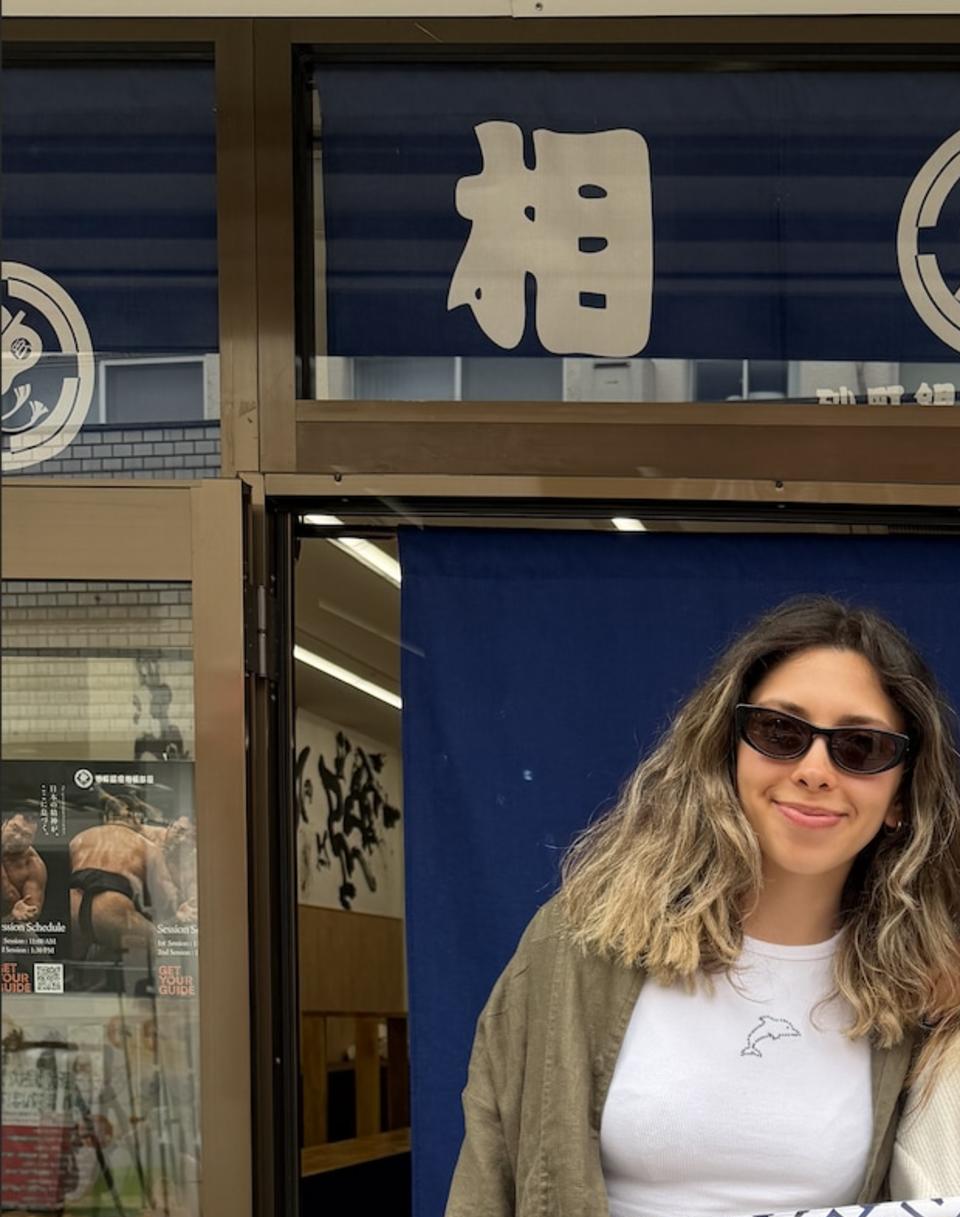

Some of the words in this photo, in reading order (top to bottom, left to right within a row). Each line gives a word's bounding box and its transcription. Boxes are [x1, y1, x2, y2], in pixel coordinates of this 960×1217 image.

[447, 120, 653, 358] 相
[26, 922, 66, 932] Schedule
[157, 924, 190, 934] Session
[159, 965, 181, 976] GET
[159, 976, 193, 986] YOUR
[159, 985, 196, 996] GUIDE
